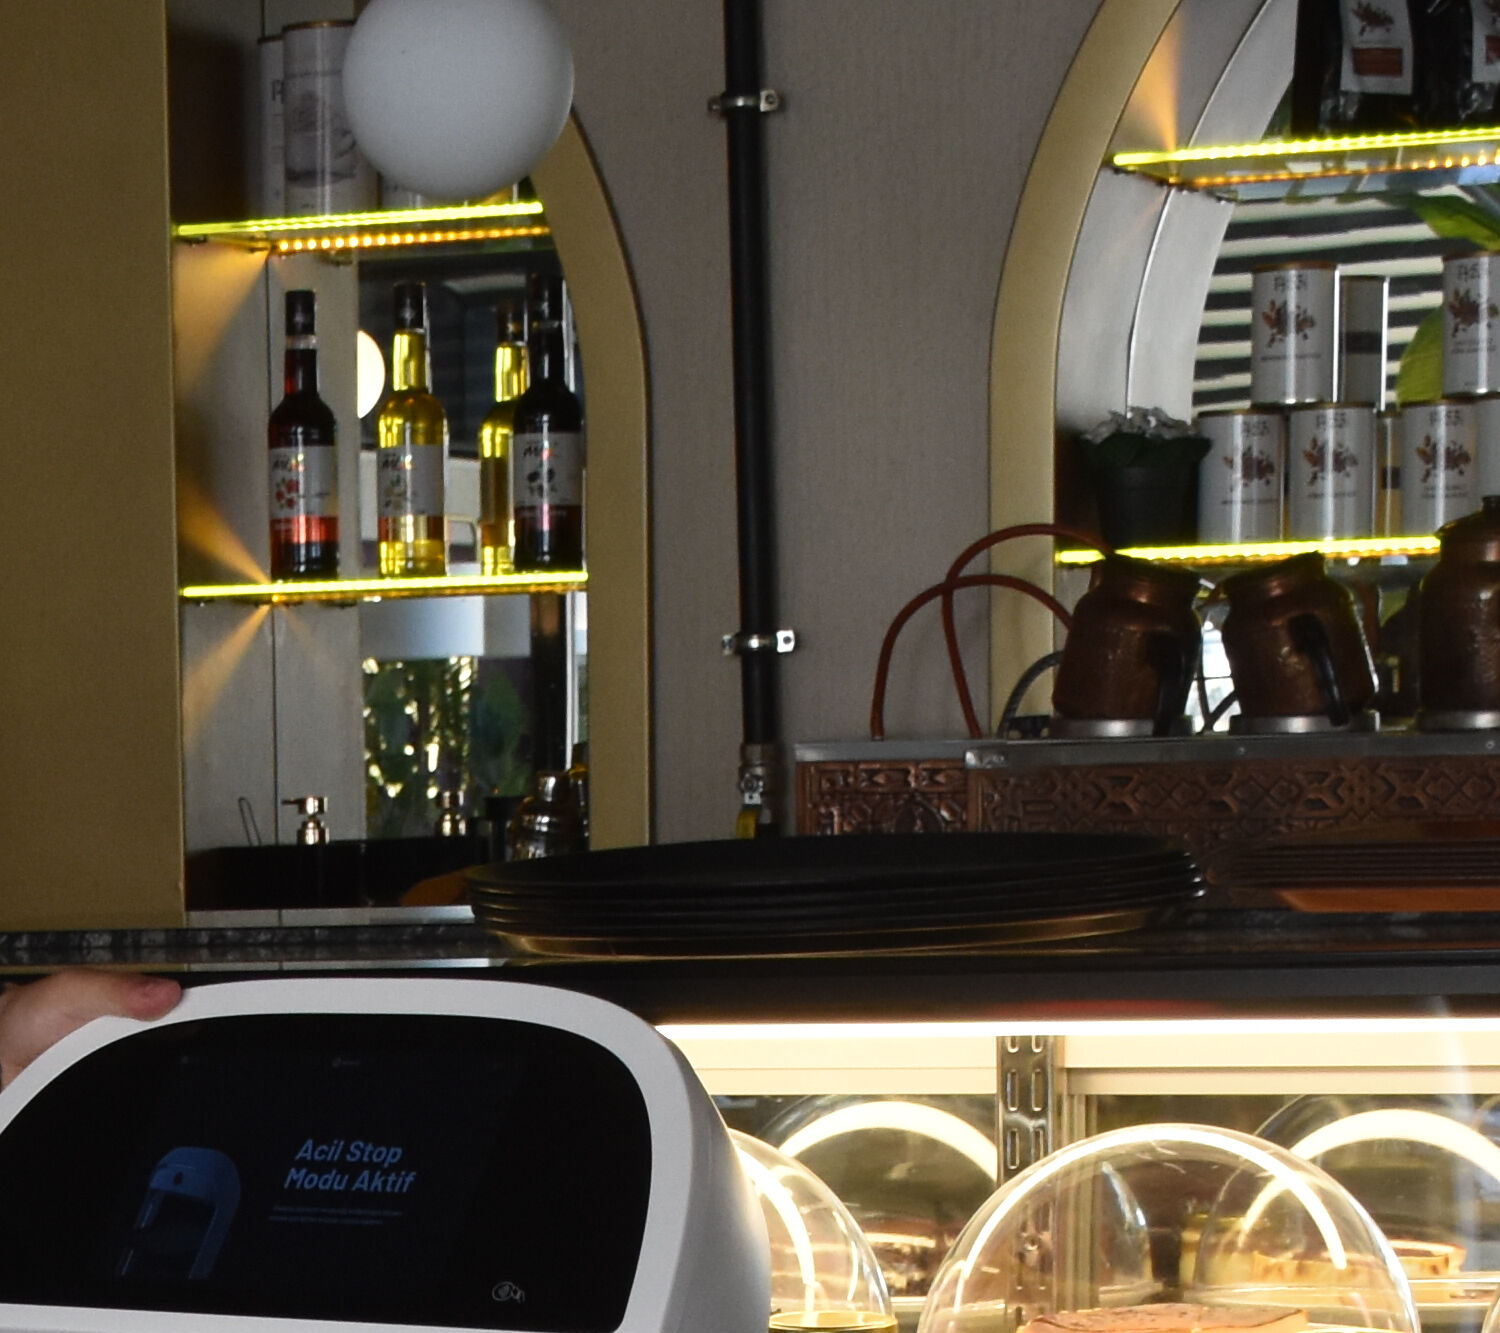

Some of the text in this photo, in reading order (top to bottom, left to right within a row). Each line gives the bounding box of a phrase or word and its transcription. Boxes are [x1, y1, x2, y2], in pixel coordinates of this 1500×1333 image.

[294, 1137, 404, 1169] Acil Stop
[283, 1166, 417, 1193] Modu Aktif
